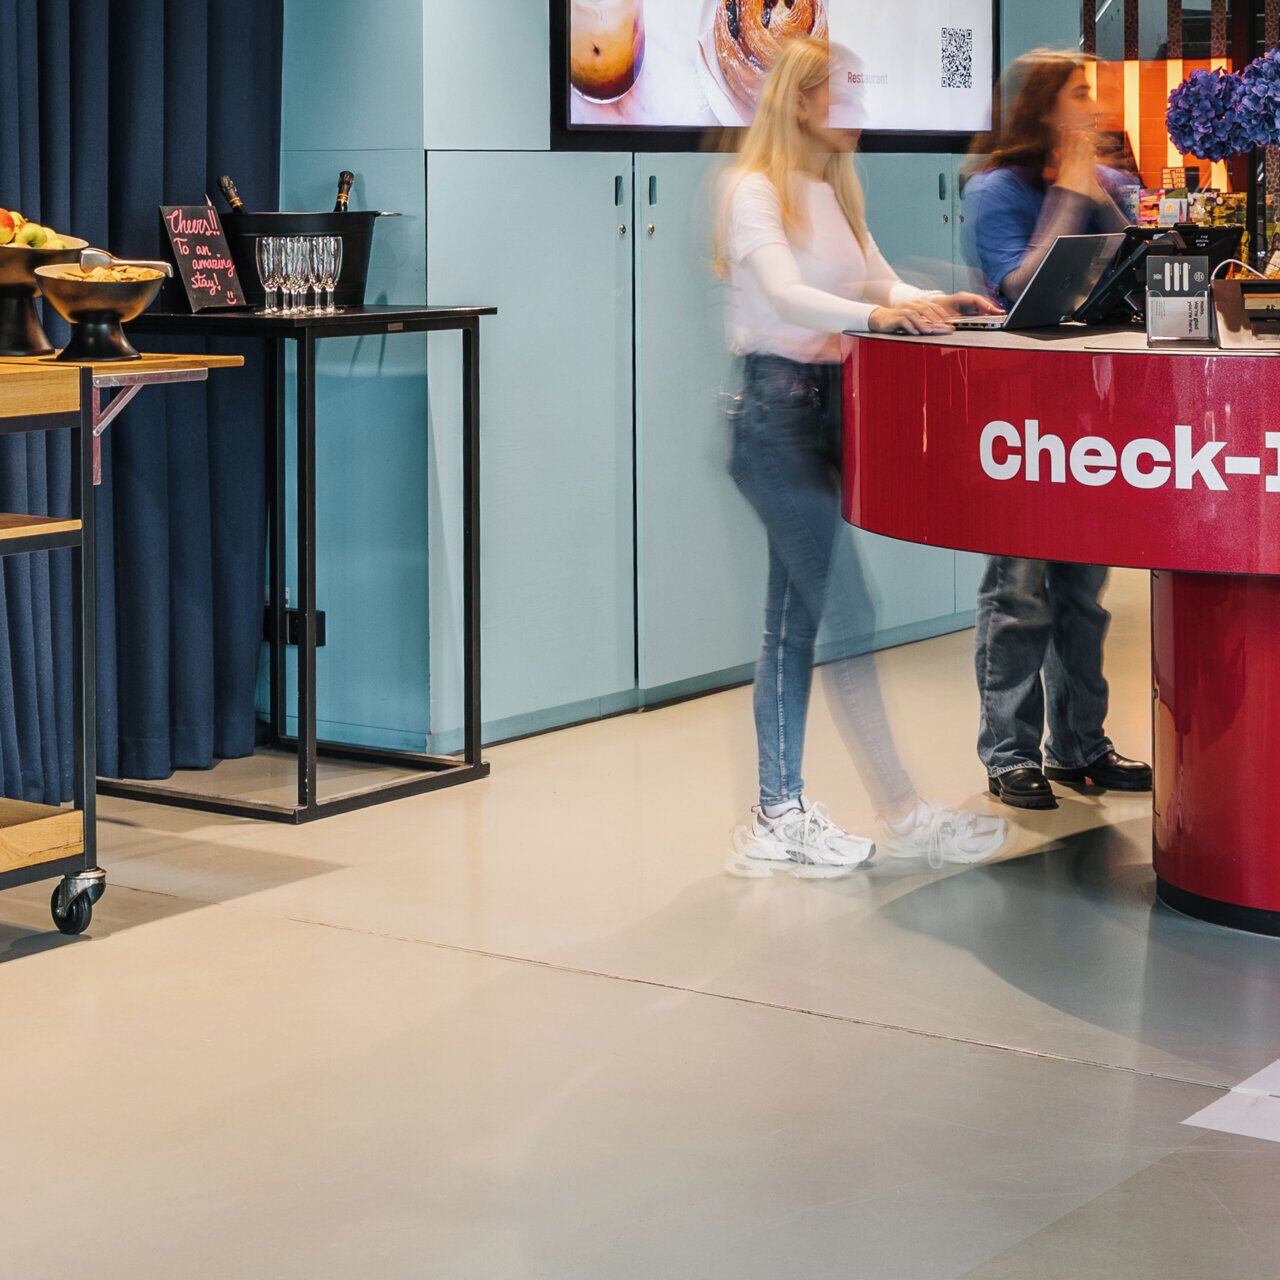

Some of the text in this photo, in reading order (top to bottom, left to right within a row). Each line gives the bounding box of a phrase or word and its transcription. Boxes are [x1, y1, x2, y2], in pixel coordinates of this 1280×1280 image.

[847, 71, 889, 85] Restaurant
[166, 208, 221, 237] Cheers!!
[173, 237, 212, 256] To an
[192, 253, 235, 278] amazing
[190, 272, 222, 296] stay!
